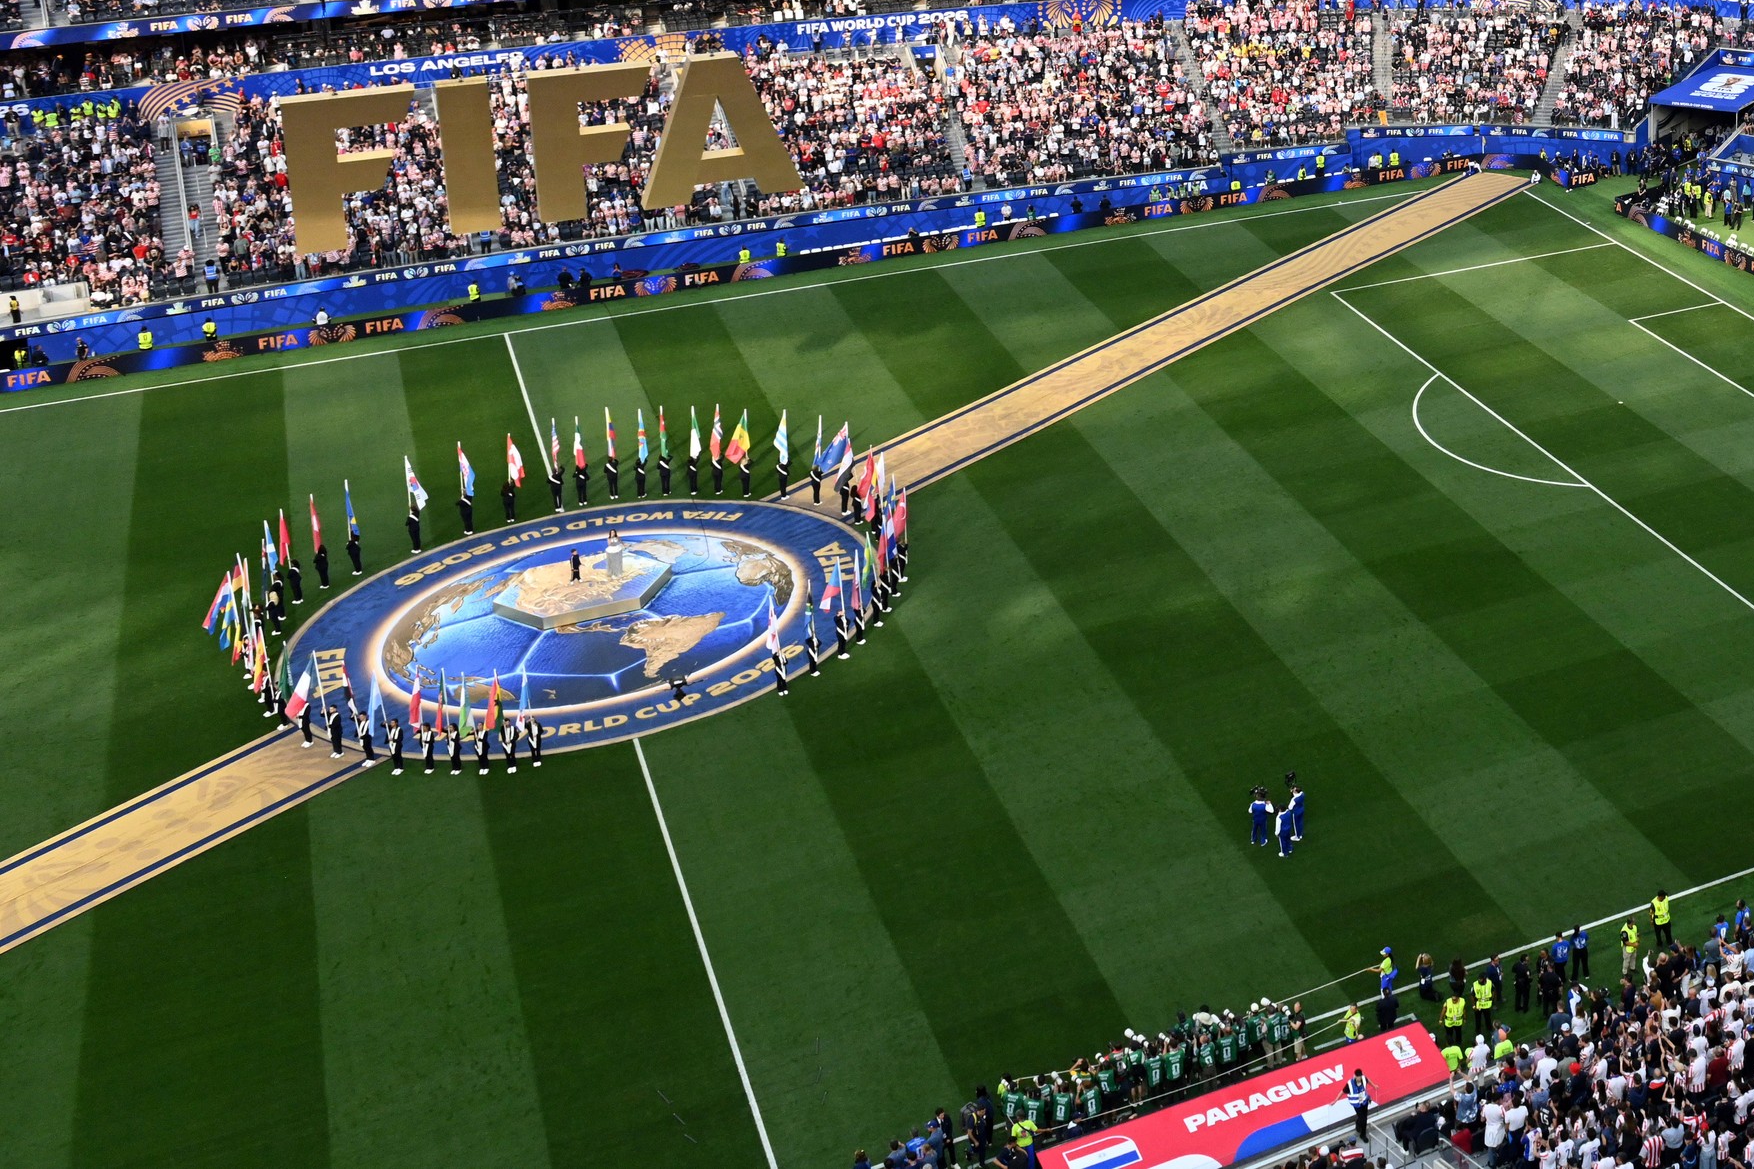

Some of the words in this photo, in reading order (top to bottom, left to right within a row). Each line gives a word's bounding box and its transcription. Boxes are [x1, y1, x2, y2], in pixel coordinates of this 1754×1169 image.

[149, 20, 179, 32] FIFA
[796, 23, 830, 35] FIFA
[830, 17, 885, 32] WORLD
[886, 14, 916, 27] CUP
[369, 62, 416, 76] LOS
[421, 51, 525, 72] ANGELES
[280, 50, 804, 255] FIFA
[1256, 152, 1273, 160] FIFA
[1378, 168, 1405, 182] FIFA
[1725, 165, 1739, 173] FIFA
[1570, 172, 1595, 186] FIFA
[1220, 192, 1248, 205] FIFA
[1144, 203, 1173, 217] FIFA
[967, 229, 999, 243] FIFA
[594, 241, 616, 251] FIFA
[882, 242, 915, 256] FIFA
[1701, 239, 1720, 256] FIFA
[539, 248, 561, 259] FIFA
[434, 263, 457, 274] FIFA
[375, 271, 398, 282] FIFA
[684, 270, 720, 286] FIFA
[263, 288, 288, 299] FIFA
[589, 284, 626, 301] FIFA
[201, 297, 225, 308] FIFA
[82, 315, 108, 326] FIFA
[365, 317, 404, 334] FIFA
[14, 326, 41, 337] FIFA
[258, 334, 298, 350] FIFA
[6, 370, 52, 388] FIFA
[566, 510, 674, 531] WORLD
[682, 510, 744, 522] FIFA
[500, 525, 561, 547] CUP
[393, 543, 497, 587] 2026
[812, 540, 855, 583] FIFA
[311, 647, 347, 699] FIFA
[634, 692, 702, 720] CUP
[1183, 1063, 1344, 1133] PARAGUAY
[1539, 1112, 1550, 1126] 15
